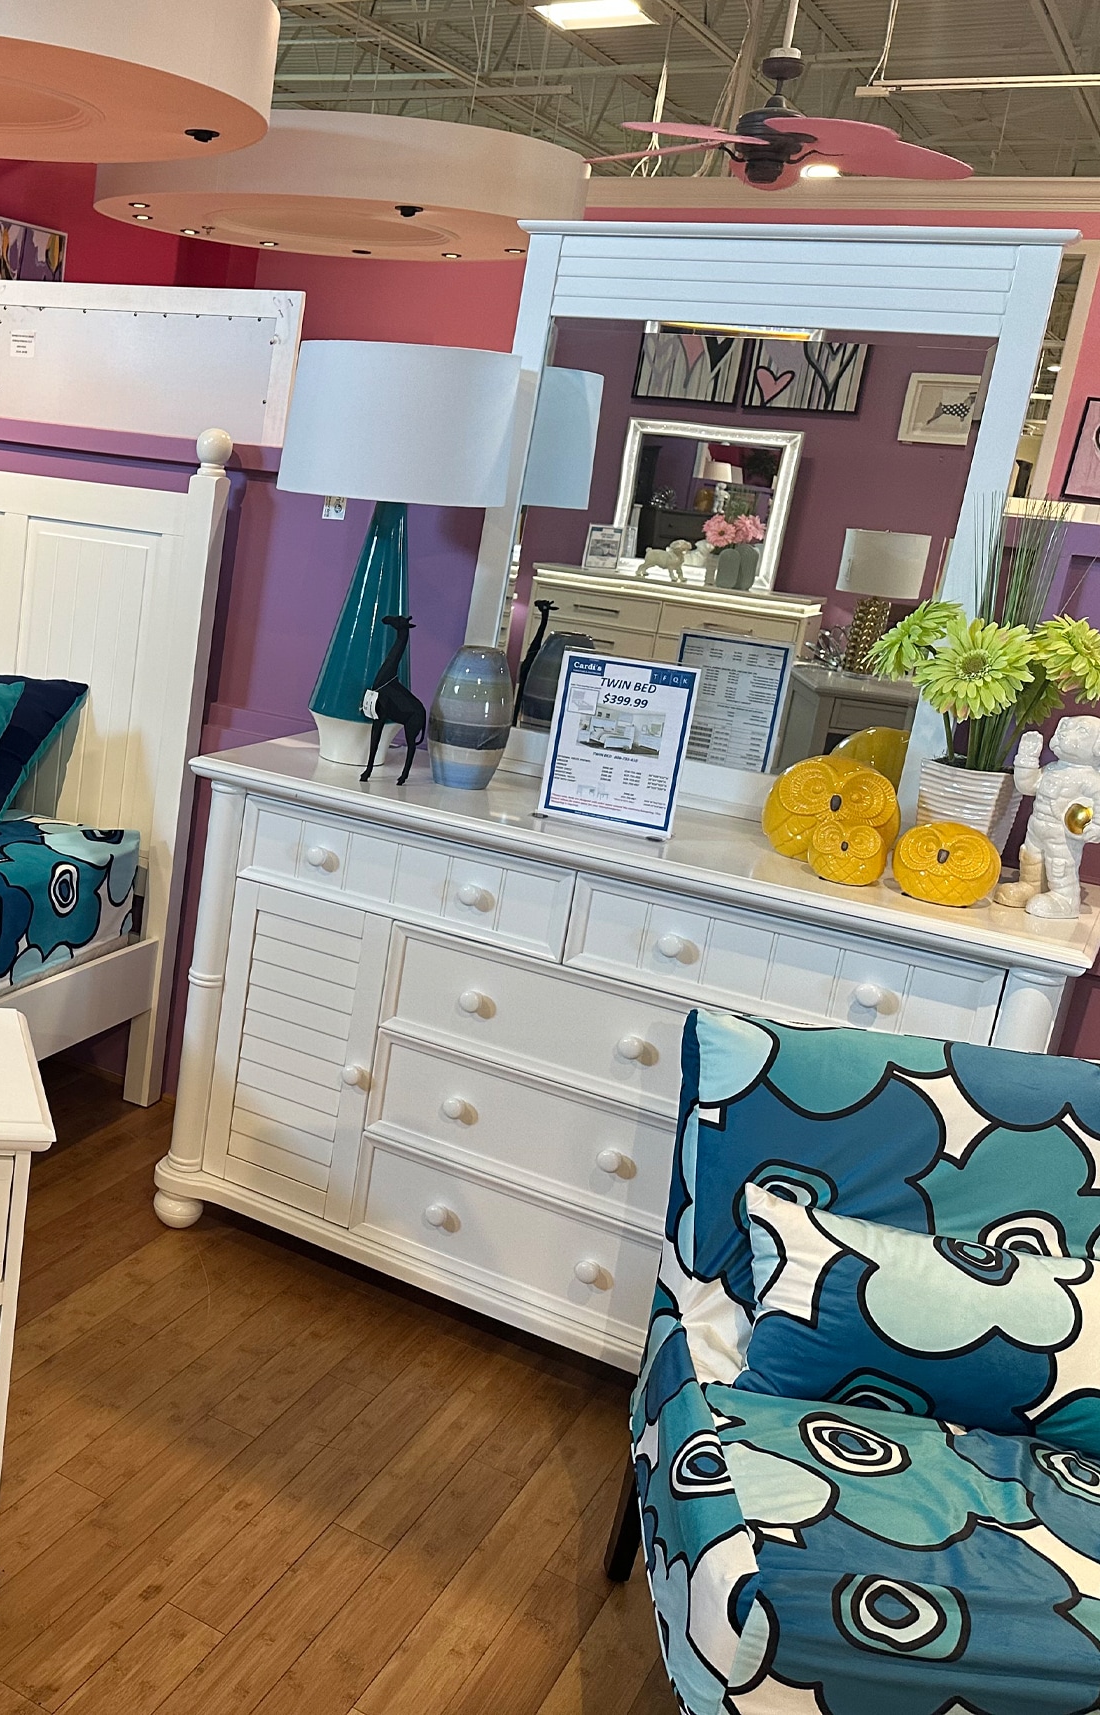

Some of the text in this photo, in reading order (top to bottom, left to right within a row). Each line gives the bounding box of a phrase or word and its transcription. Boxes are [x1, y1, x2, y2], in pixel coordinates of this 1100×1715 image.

[573, 661, 602, 672] Cardi's
[600, 677, 632, 690] TWIN
[633, 682, 657, 694] BED
[602, 692, 649, 709] $399.99
